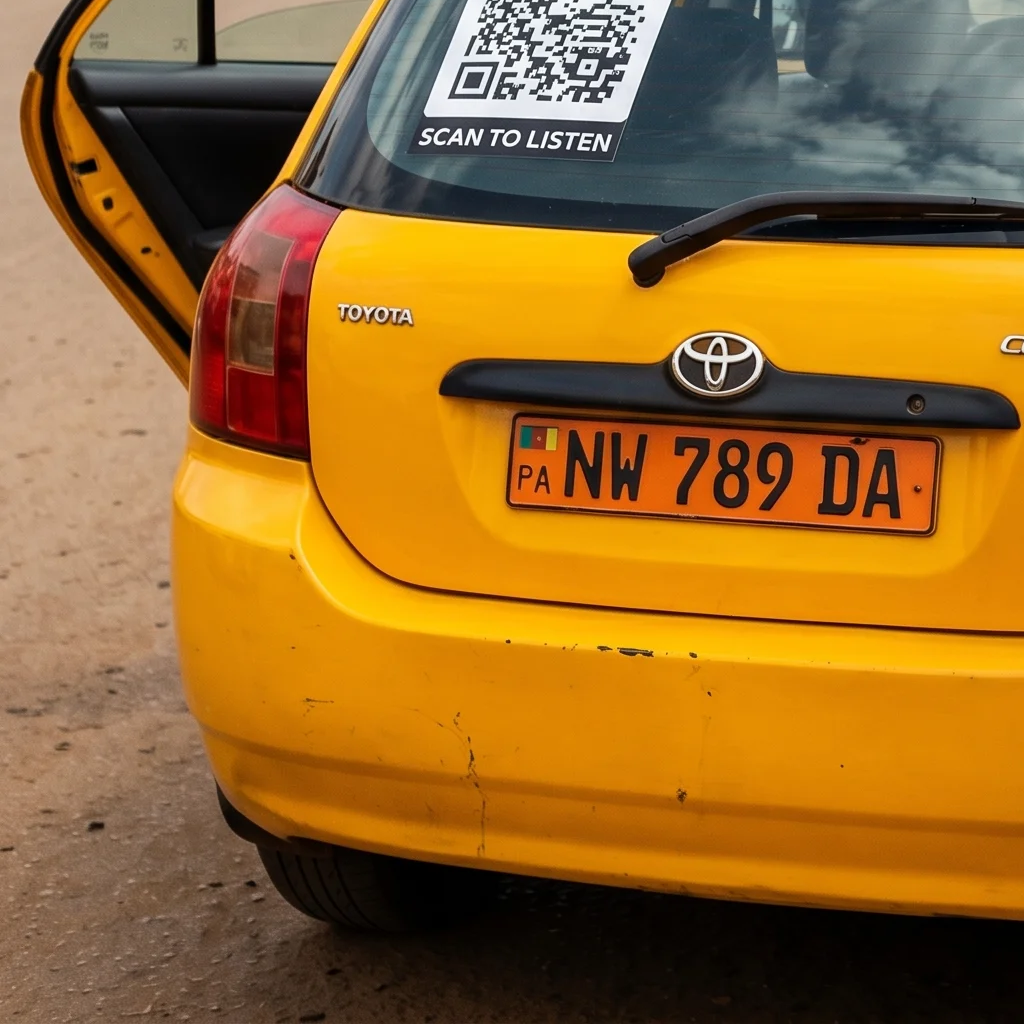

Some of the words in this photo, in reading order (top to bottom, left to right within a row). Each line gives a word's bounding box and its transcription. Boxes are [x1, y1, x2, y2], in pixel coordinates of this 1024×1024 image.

[418, 128, 485, 147] SCAN
[490, 129, 521, 148] TO
[526, 130, 613, 153] LISTEN
[337, 303, 414, 327] TOYOTA
[517, 464, 551, 495] PA
[564, 429, 648, 502] NW
[674, 435, 794, 512] 789
[817, 445, 901, 519] DA
